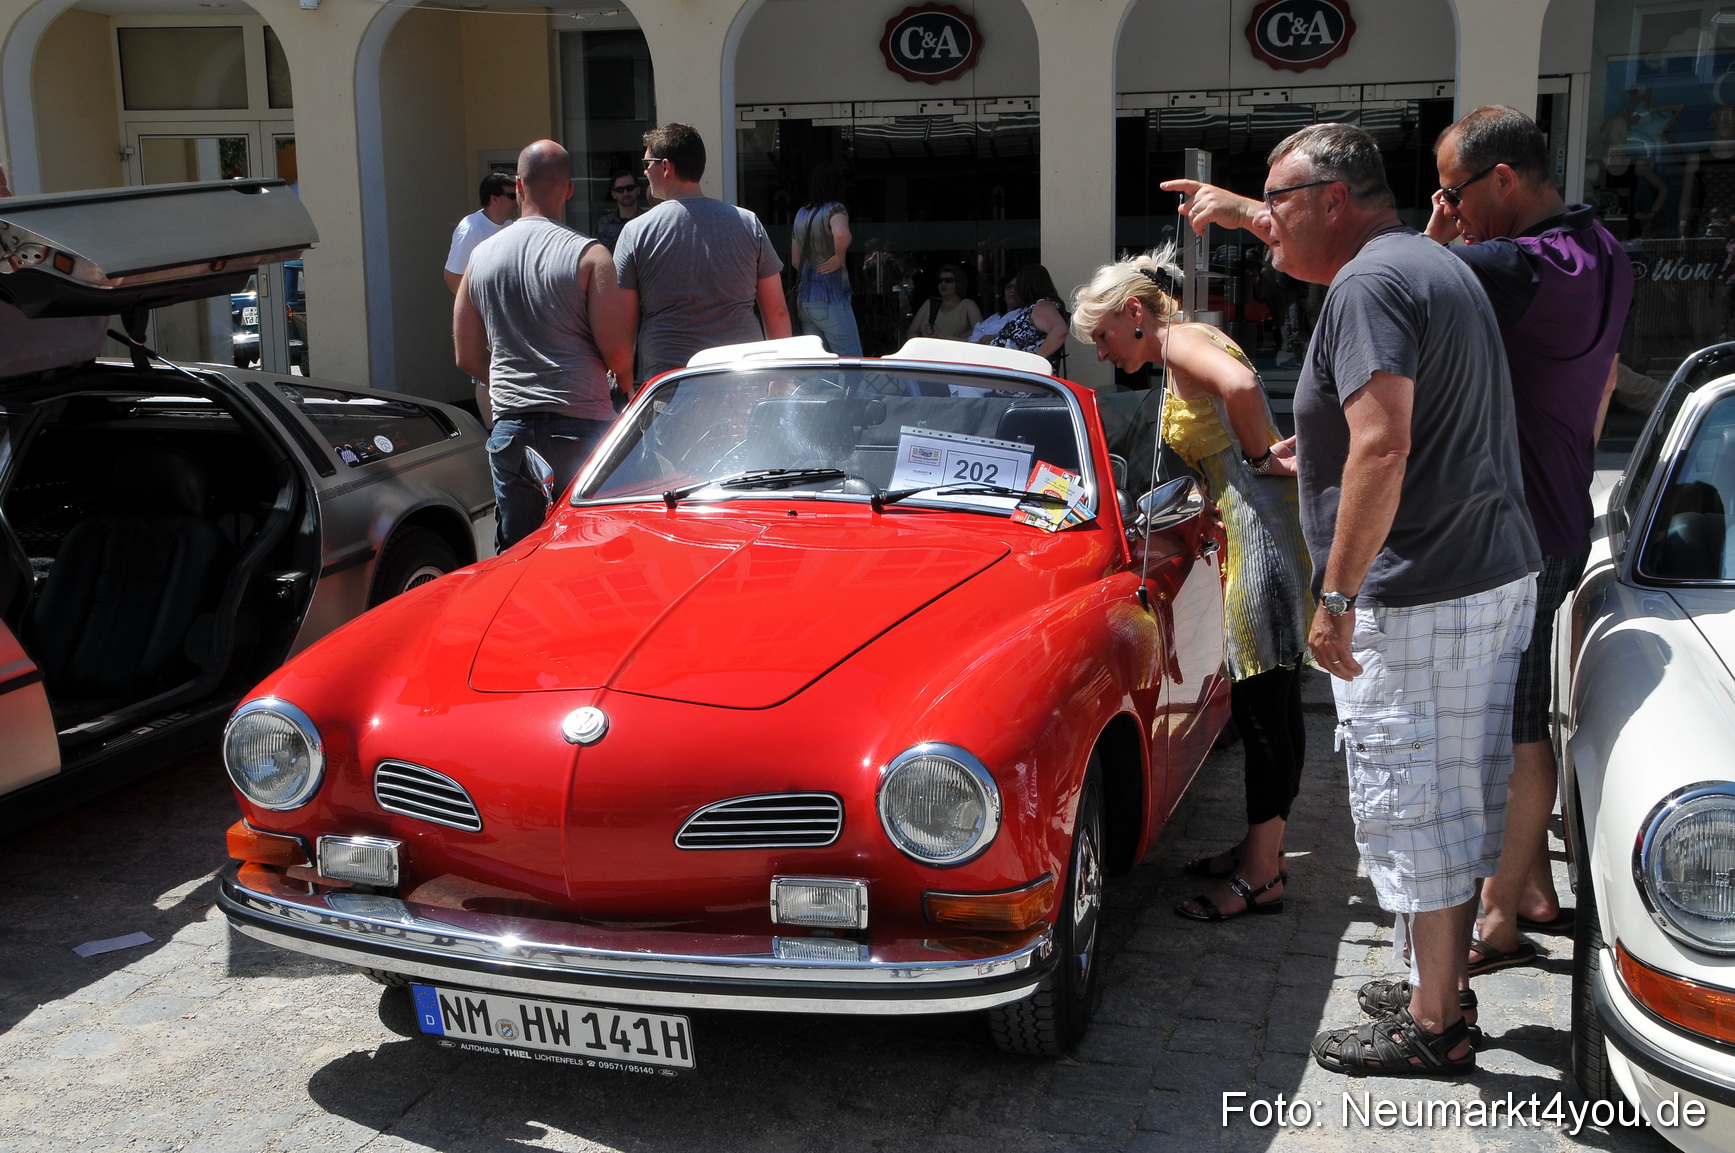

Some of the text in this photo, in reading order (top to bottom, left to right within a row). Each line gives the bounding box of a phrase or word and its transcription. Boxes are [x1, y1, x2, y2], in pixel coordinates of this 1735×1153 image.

[900, 25, 963, 59] C&A
[1267, 10, 1335, 47] C&A
[1651, 254, 1733, 281] Wow!
[953, 459, 999, 484] 202
[425, 1014, 435, 1025] D
[439, 994, 689, 1060] NM HW 141H
[460, 1043, 500, 1054] AUTOHAUS
[502, 1048, 532, 1059] THIEL
[534, 1053, 583, 1066] LICHTENFELS
